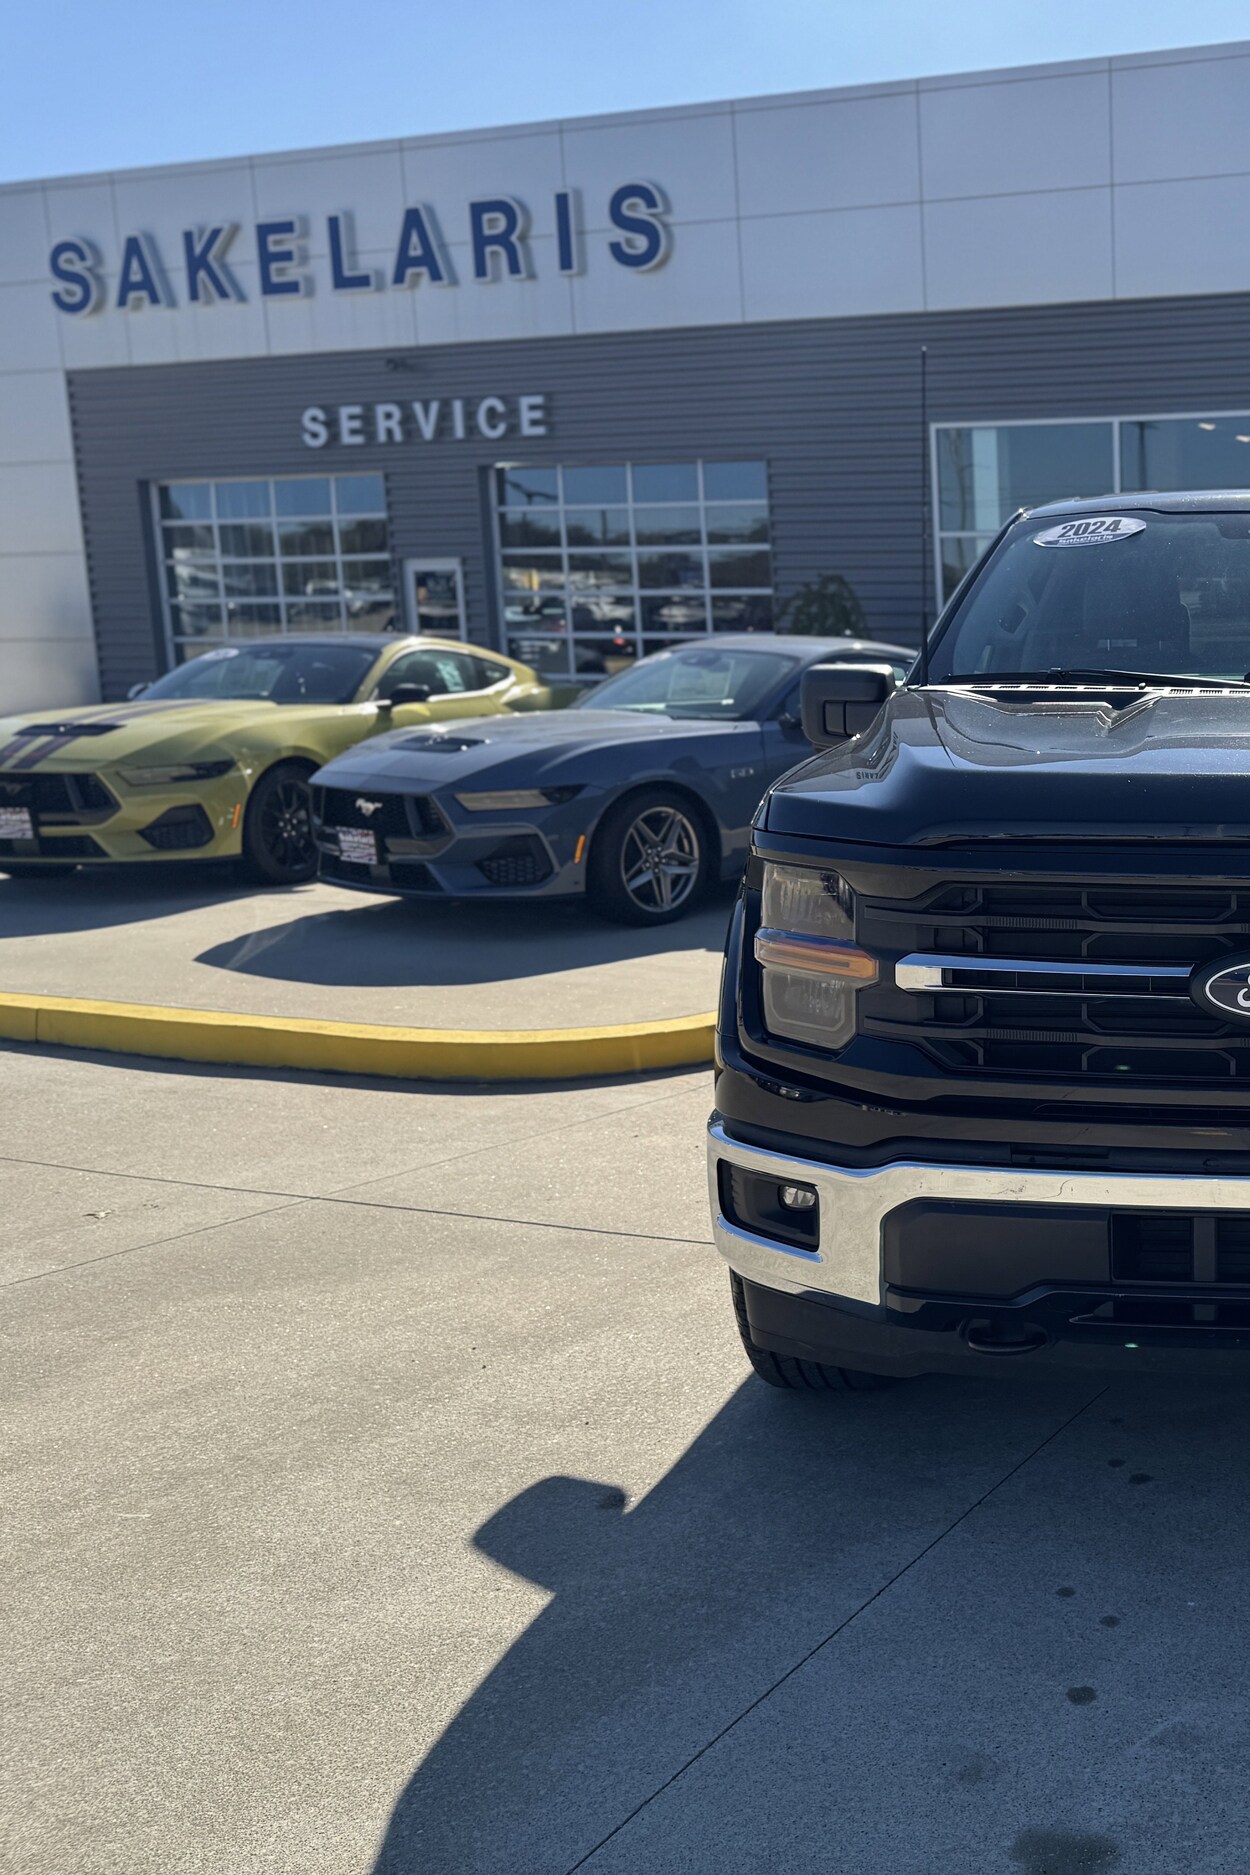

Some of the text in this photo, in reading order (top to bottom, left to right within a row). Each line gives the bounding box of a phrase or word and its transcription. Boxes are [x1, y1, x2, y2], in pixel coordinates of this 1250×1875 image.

[48, 181, 671, 316] SAKELARIS
[301, 395, 549, 449] SERVICE
[1056, 519, 1123, 539] 2024
